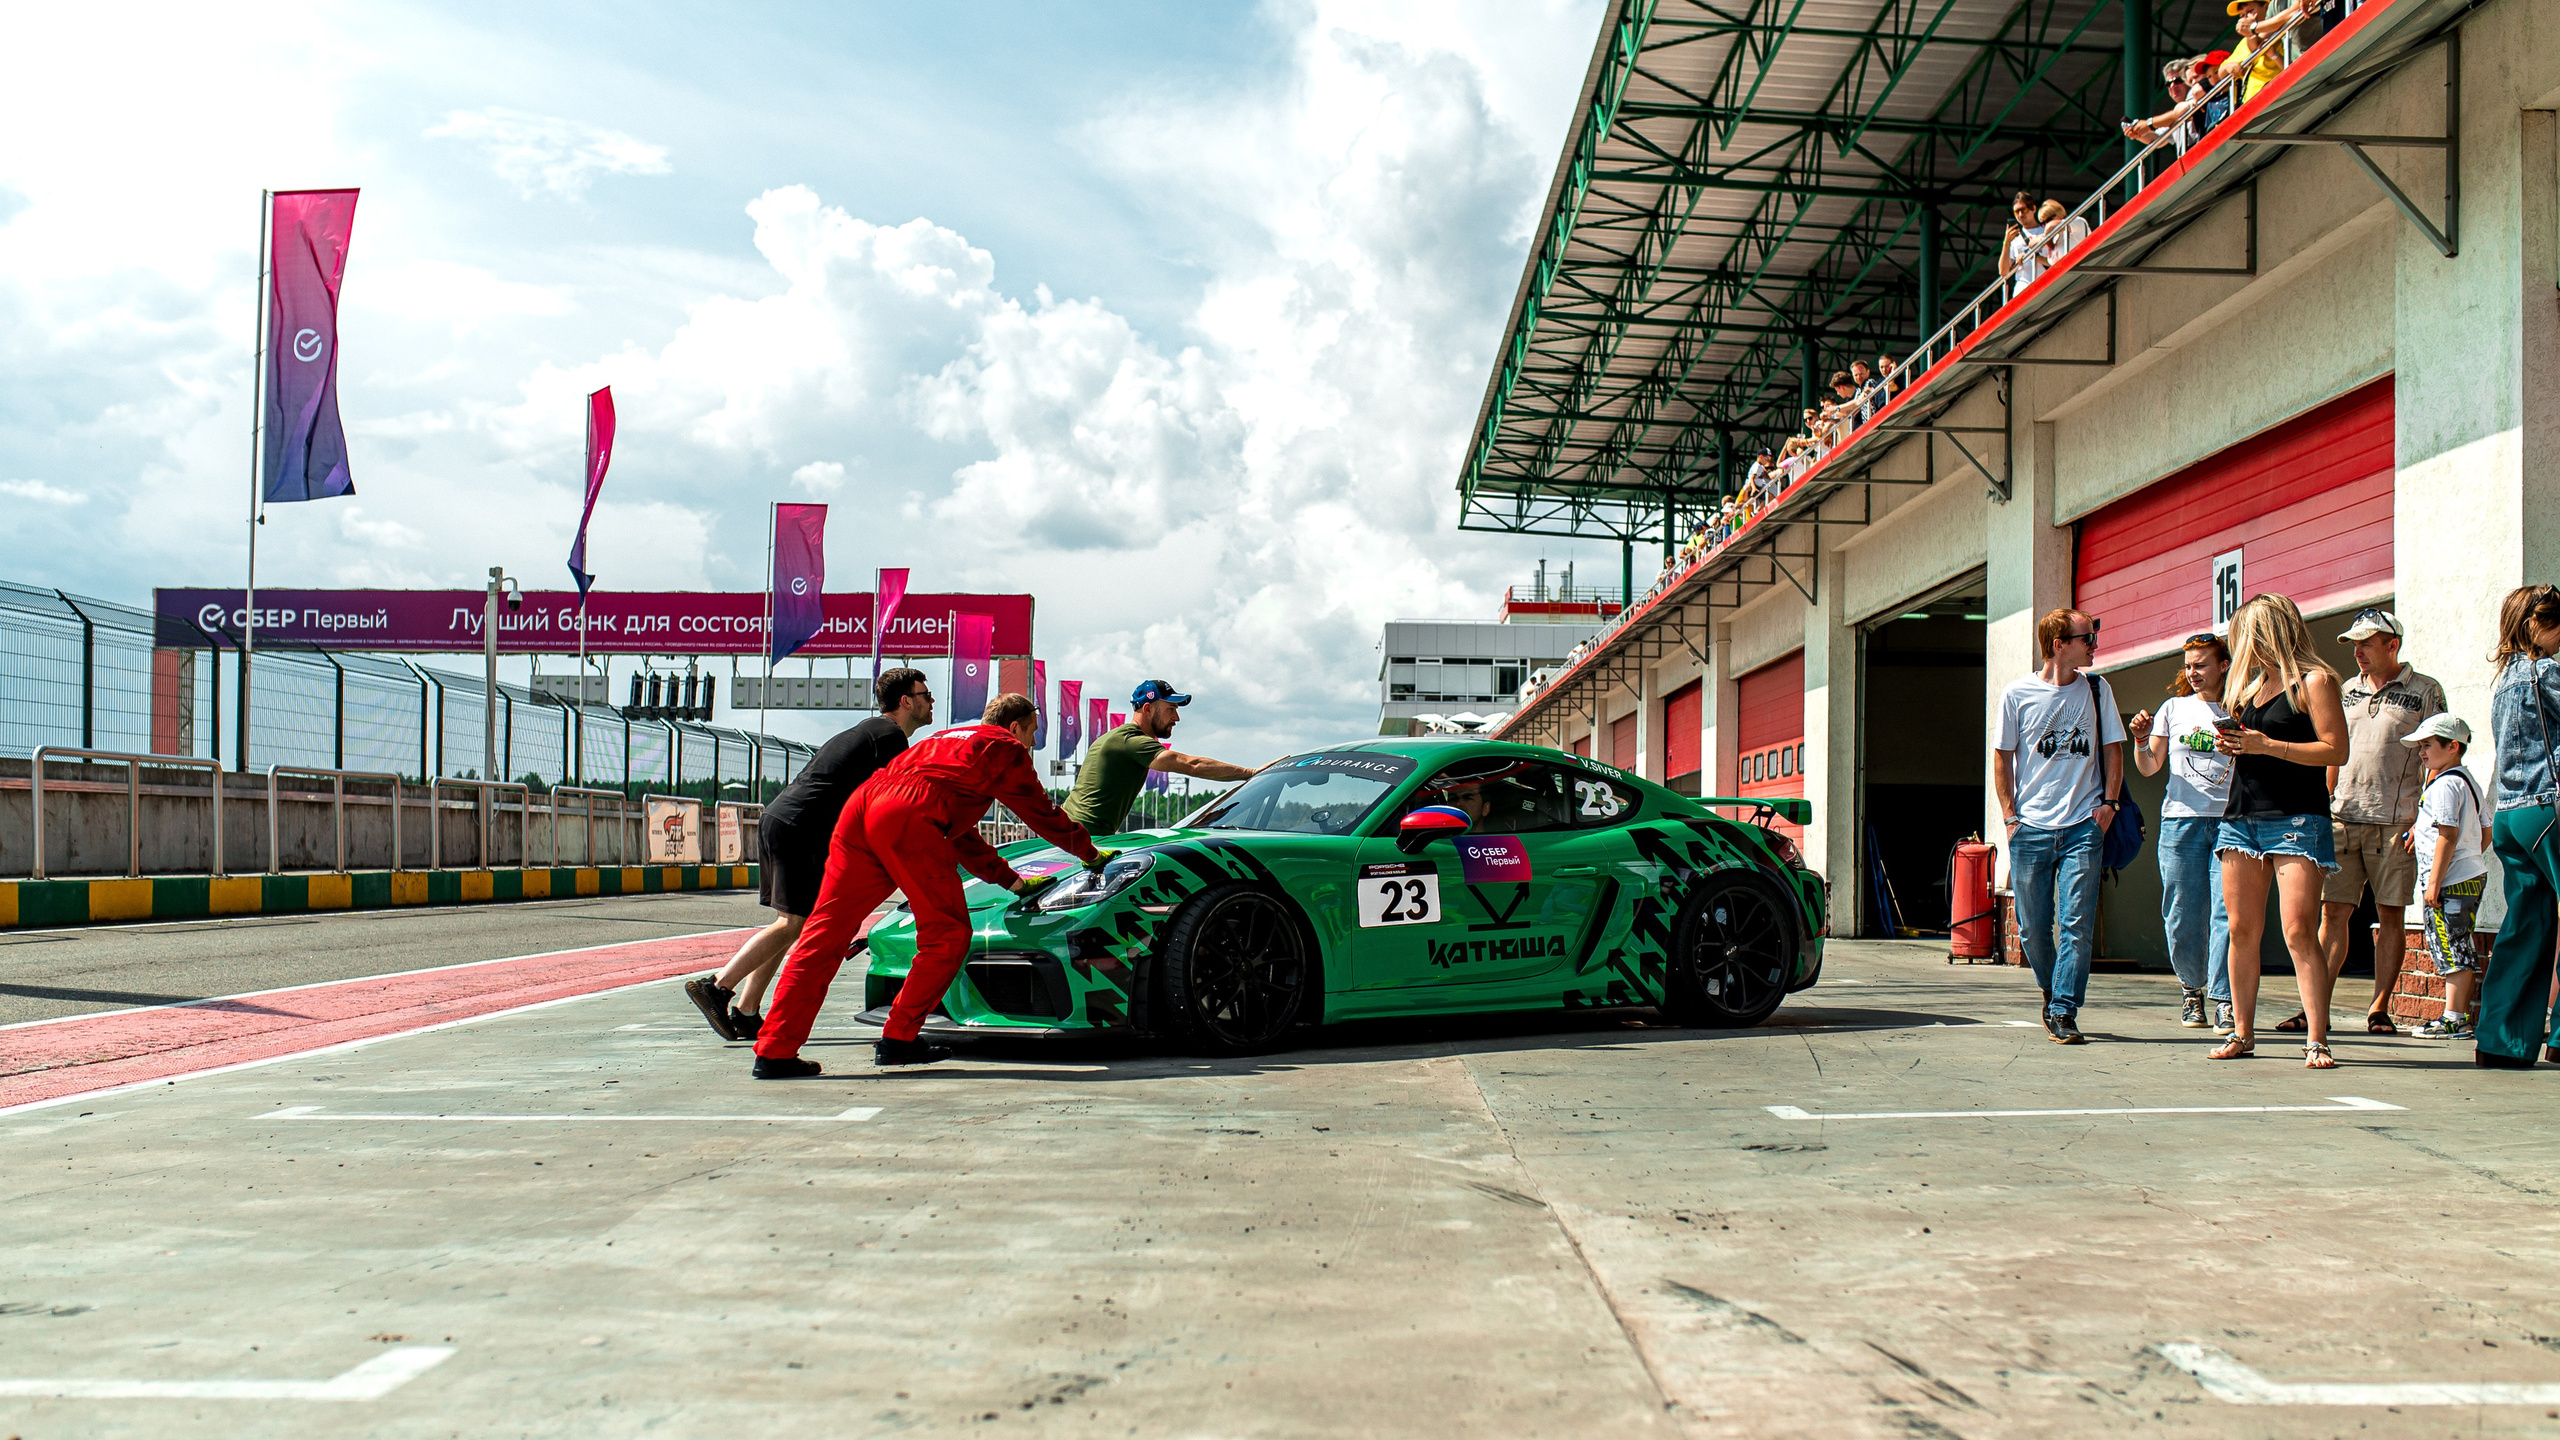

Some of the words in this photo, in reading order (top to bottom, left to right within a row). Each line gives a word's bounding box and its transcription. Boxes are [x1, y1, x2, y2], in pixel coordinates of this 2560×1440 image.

[2216, 563, 2238, 624] 15
[232, 609, 296, 628] СБЕР
[303, 608, 388, 632] Первый
[449, 608, 549, 635] Луший
[624, 615, 671, 635] для
[1580, 757, 1623, 780] V.SIVER
[1575, 781, 1619, 816] 23
[1481, 847, 1508, 857] СБЕР
[1485, 855, 1521, 867] Первый
[1380, 879, 1429, 922] 23
